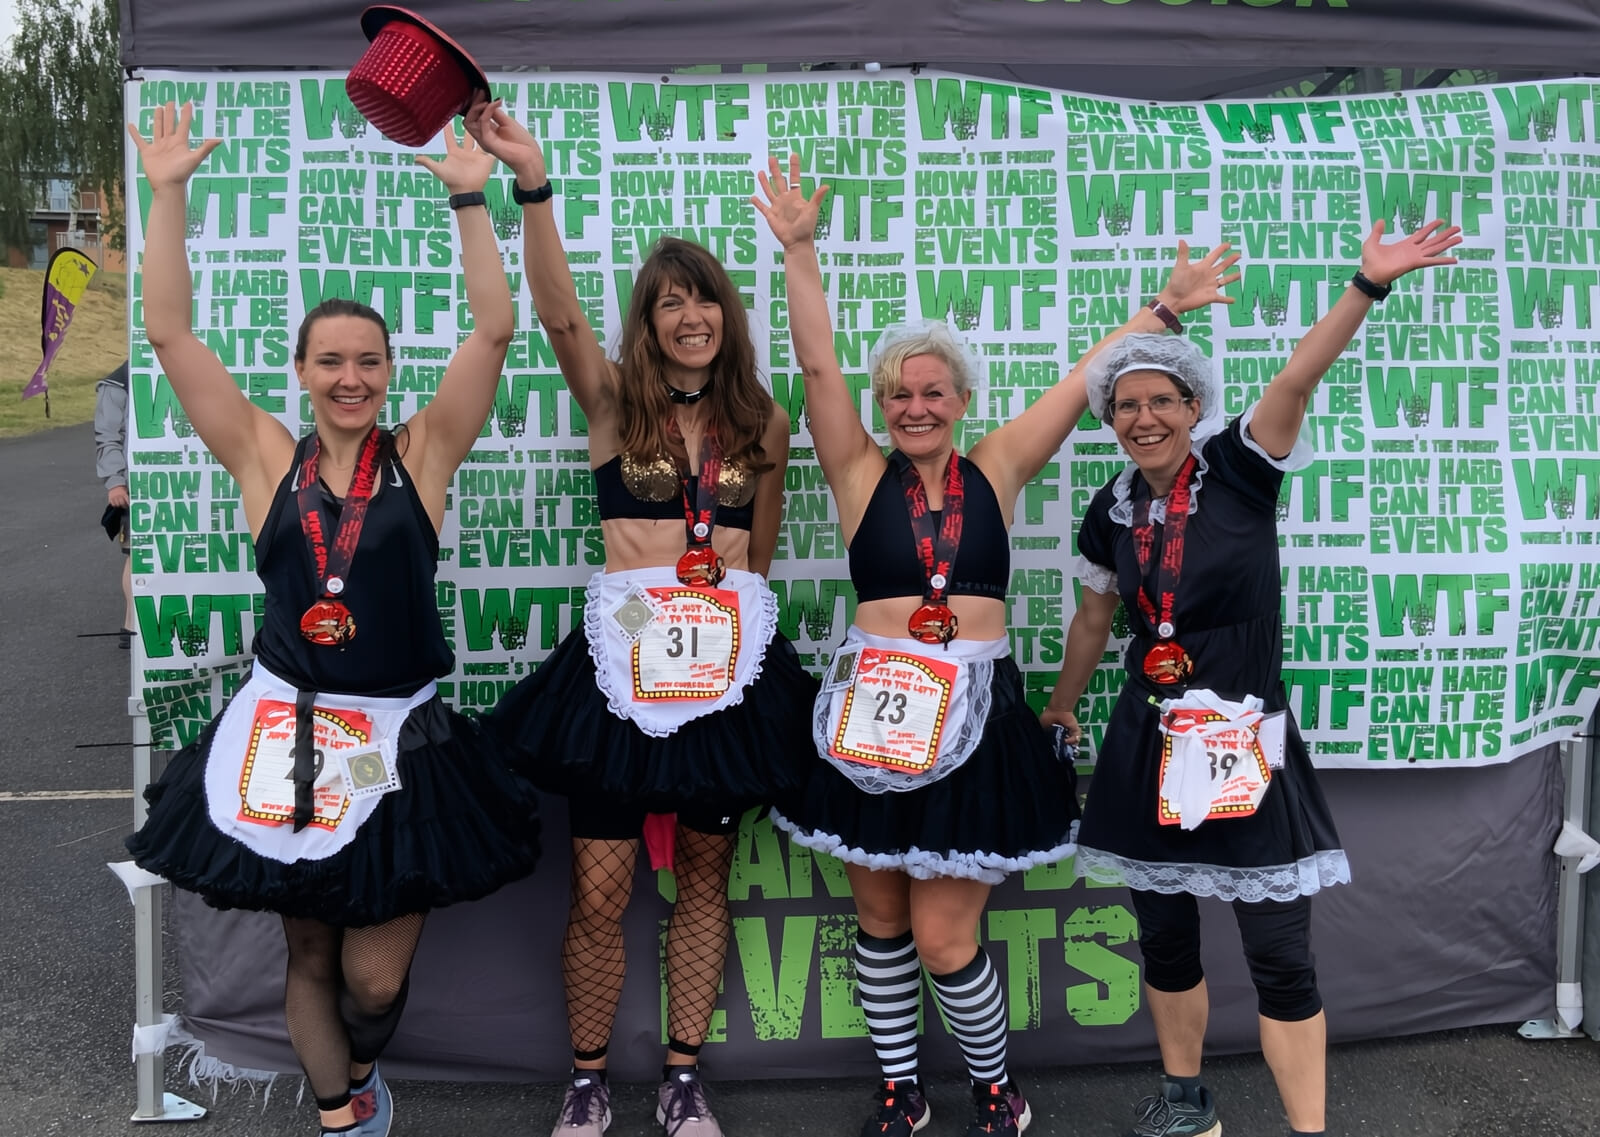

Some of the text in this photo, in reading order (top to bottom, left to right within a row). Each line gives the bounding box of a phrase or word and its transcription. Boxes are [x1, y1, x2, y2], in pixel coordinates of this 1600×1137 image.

[140, 81, 290, 107] HOW HARD
[528, 83, 599, 109] HARD
[765, 81, 905, 107] HOW HARD
[1346, 92, 1488, 118] HOW HARD
[215, 109, 290, 136] IT BE
[608, 82, 749, 141] WTF
[914, 79, 1053, 140] WTF
[1061, 95, 1198, 123] HOW HARD
[1204, 101, 1345, 143] WTF
[1492, 84, 1600, 142] WT
[528, 112, 599, 138] IT BE
[767, 108, 905, 138] CAN IT BE
[1068, 112, 1206, 137] CAN IT BE
[1351, 112, 1494, 139] CAN IT BE
[676, 153, 699, 164] THE
[768, 137, 907, 176] EVENTS
[979, 151, 1002, 164] THE
[1067, 134, 1212, 171] EVENTS
[1285, 151, 1306, 160] THE
[1363, 138, 1494, 173] EVENTS
[1560, 154, 1582, 166] THE
[299, 169, 448, 198] HOW HARD
[611, 171, 754, 196] HOW HARD
[915, 170, 1057, 196] HOW HARD
[1221, 164, 1360, 191] HOW HARD
[1502, 171, 1559, 196] HOW
[299, 197, 450, 228] CAN IT BE
[612, 197, 755, 226] CAN IT BE
[916, 197, 1057, 227] CAN IT BE
[1067, 172, 1210, 237] WTF
[1221, 192, 1361, 221] CAN IT BE
[1364, 173, 1492, 236] WTF
[1505, 197, 1586, 226] CAN IT
[299, 228, 452, 267] EVENTS
[915, 228, 1058, 264] EVENTS
[1133, 249, 1156, 261] THE
[1221, 224, 1361, 259] EVENTS
[206, 252, 231, 262] THE
[832, 253, 853, 266] THE
[211, 270, 288, 296] HARD
[839, 273, 906, 299] HARD
[1068, 269, 1131, 296] HOW
[1434, 269, 1497, 292] HARD
[211, 299, 288, 327] IT BE
[916, 270, 1056, 331] WTF
[1068, 297, 1131, 325] CAN
[1368, 296, 1499, 323] CAN IT BE
[838, 300, 906, 329] IT BE
[982, 342, 1004, 355] THE
[1366, 325, 1500, 361] EVENTS
[1568, 341, 1586, 352] THE
[989, 361, 1059, 388] HARD
[1508, 359, 1566, 384] HOW
[1329, 386, 1362, 414] BE
[1366, 366, 1498, 428] WTF
[1508, 386, 1595, 414] CAN IT
[528, 451, 552, 462] THE
[1432, 441, 1452, 452] THE
[459, 469, 526, 496] HOW
[1369, 459, 1502, 484] HOW HARD
[131, 471, 201, 500] HOW
[459, 499, 558, 528] CAN IT
[1370, 487, 1504, 514] CAN IT BE
[131, 502, 239, 532] CAN IT
[459, 529, 606, 567] EVENTS
[1370, 517, 1508, 554] EVENTS
[1299, 566, 1368, 592] HARD
[1520, 563, 1572, 589] HOW
[681, 604, 702, 613] JUST
[1033, 599, 1062, 626] BE
[1298, 595, 1368, 624] IT BE
[1372, 573, 1509, 637] WTF
[1520, 590, 1594, 618] CAN IT
[669, 615, 681, 623] TO
[685, 614, 702, 623] THE
[666, 626, 698, 658] 31
[1437, 648, 1459, 660] THE
[881, 678, 892, 688] TO
[894, 681, 912, 691] THE
[892, 669, 915, 681] JUST
[1371, 666, 1506, 692] HOW HARD
[1515, 655, 1600, 722] WTF
[144, 679, 211, 706] HOW
[146, 697, 211, 724] CAN
[873, 690, 907, 725] 23
[1370, 692, 1504, 723] CAN IT BE
[1368, 722, 1502, 760] EVENTS
